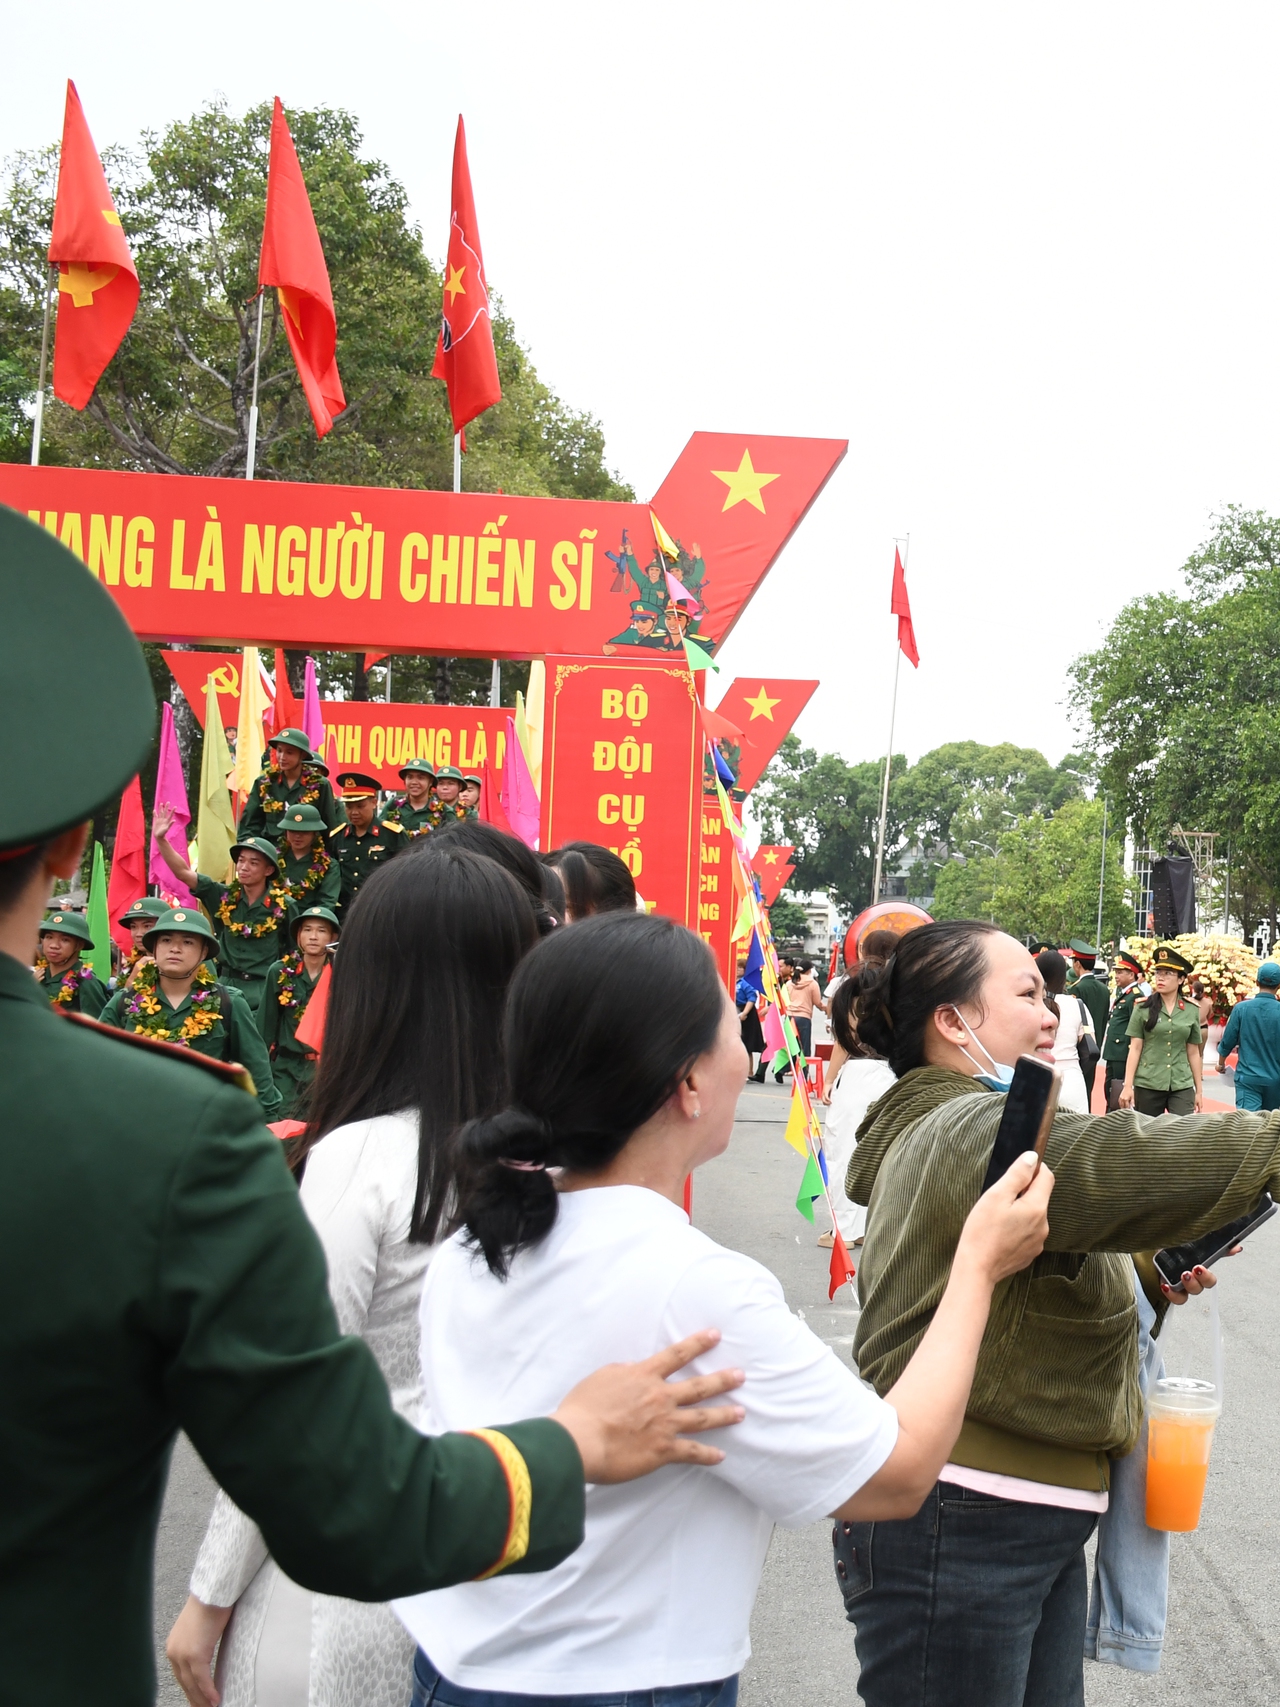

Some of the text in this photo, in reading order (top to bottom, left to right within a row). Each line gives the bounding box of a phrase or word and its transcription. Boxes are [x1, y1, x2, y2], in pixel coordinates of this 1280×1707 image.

[169, 505, 226, 592] LÀ
[242, 510, 385, 600] NGƯỜI
[399, 514, 536, 608] CHIẾN
[549, 528, 598, 611] SĨ
[602, 683, 649, 727] BỘ
[369, 725, 452, 769] QUANG
[459, 721, 488, 768] LÀ
[592, 735, 652, 779] ĐỘI
[597, 794, 645, 832] CỤ
[609, 837, 643, 878] Ồ
